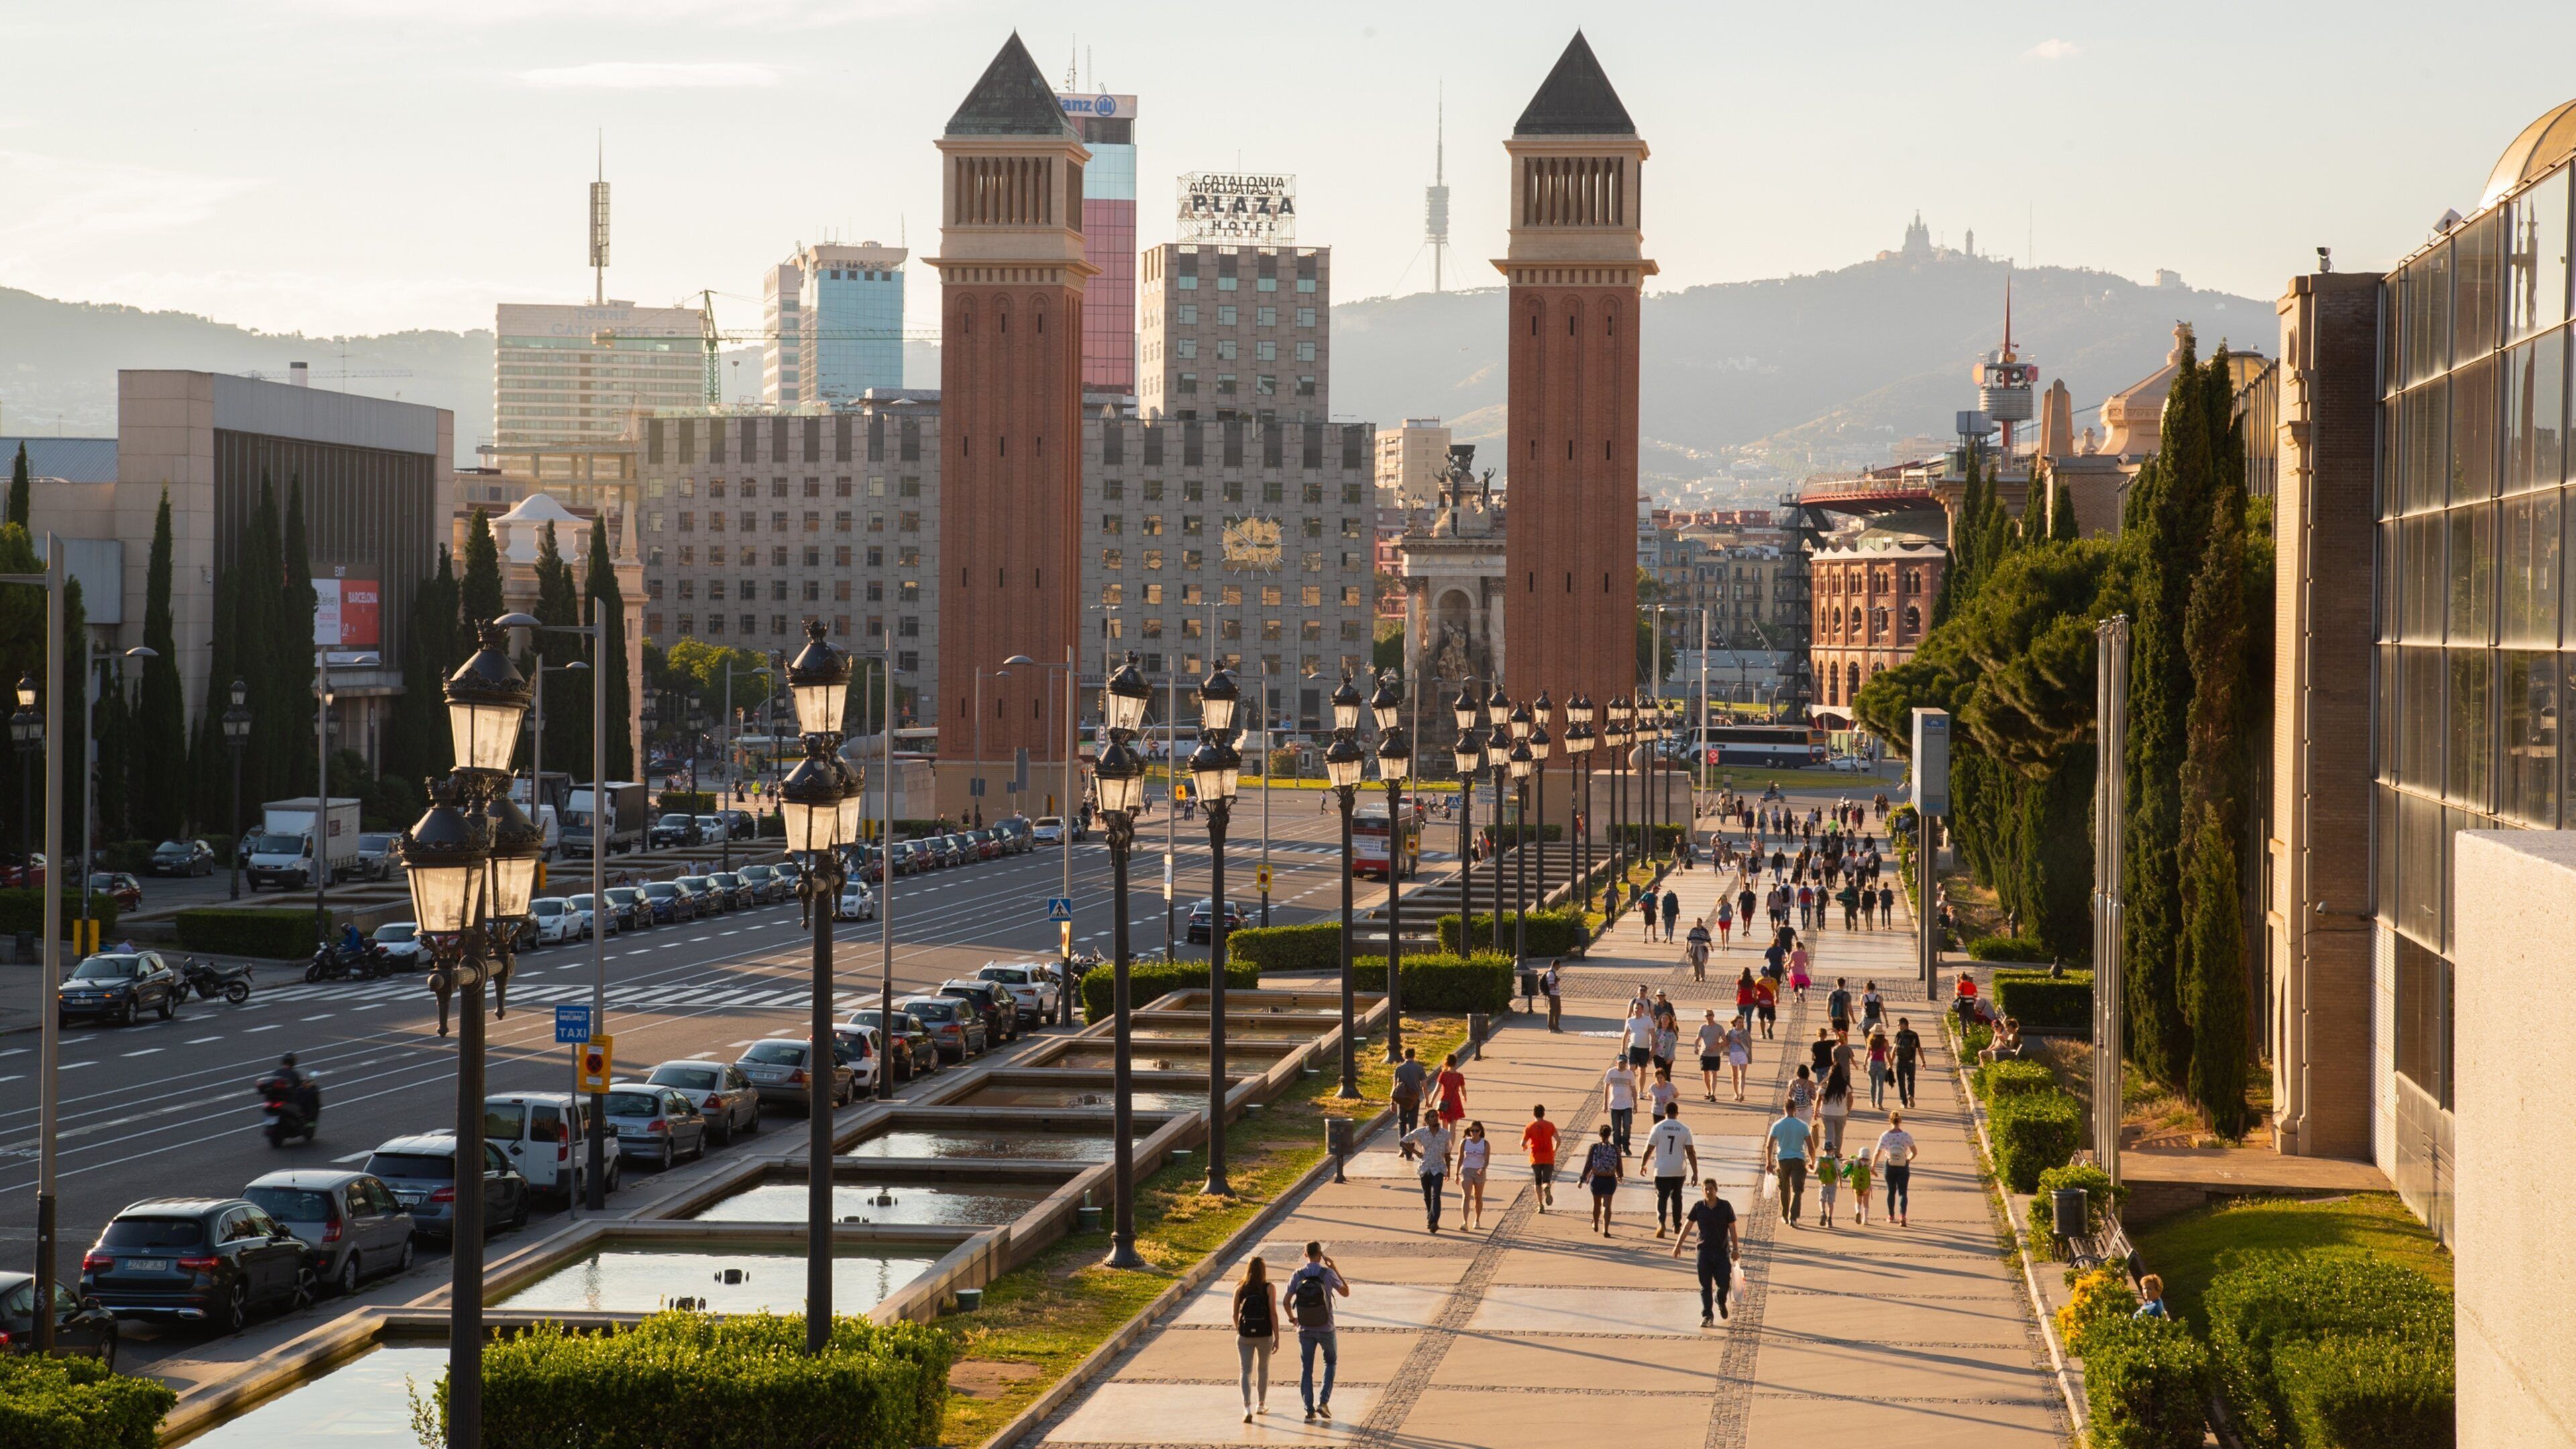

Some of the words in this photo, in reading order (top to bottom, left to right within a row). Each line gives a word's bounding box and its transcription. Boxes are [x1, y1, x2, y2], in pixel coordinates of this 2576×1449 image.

[1203, 175, 1285, 188] CATALONIA
[1192, 195, 1295, 214] PLAZA
[1212, 221, 1275, 231] HOTEL
[575, 307, 629, 320] TORRE
[335, 566, 345, 577] EXIT
[347, 592, 377, 603] BARCELONA
[559, 1028, 586, 1038] TAXI
[1667, 1135, 1675, 1155] 7
